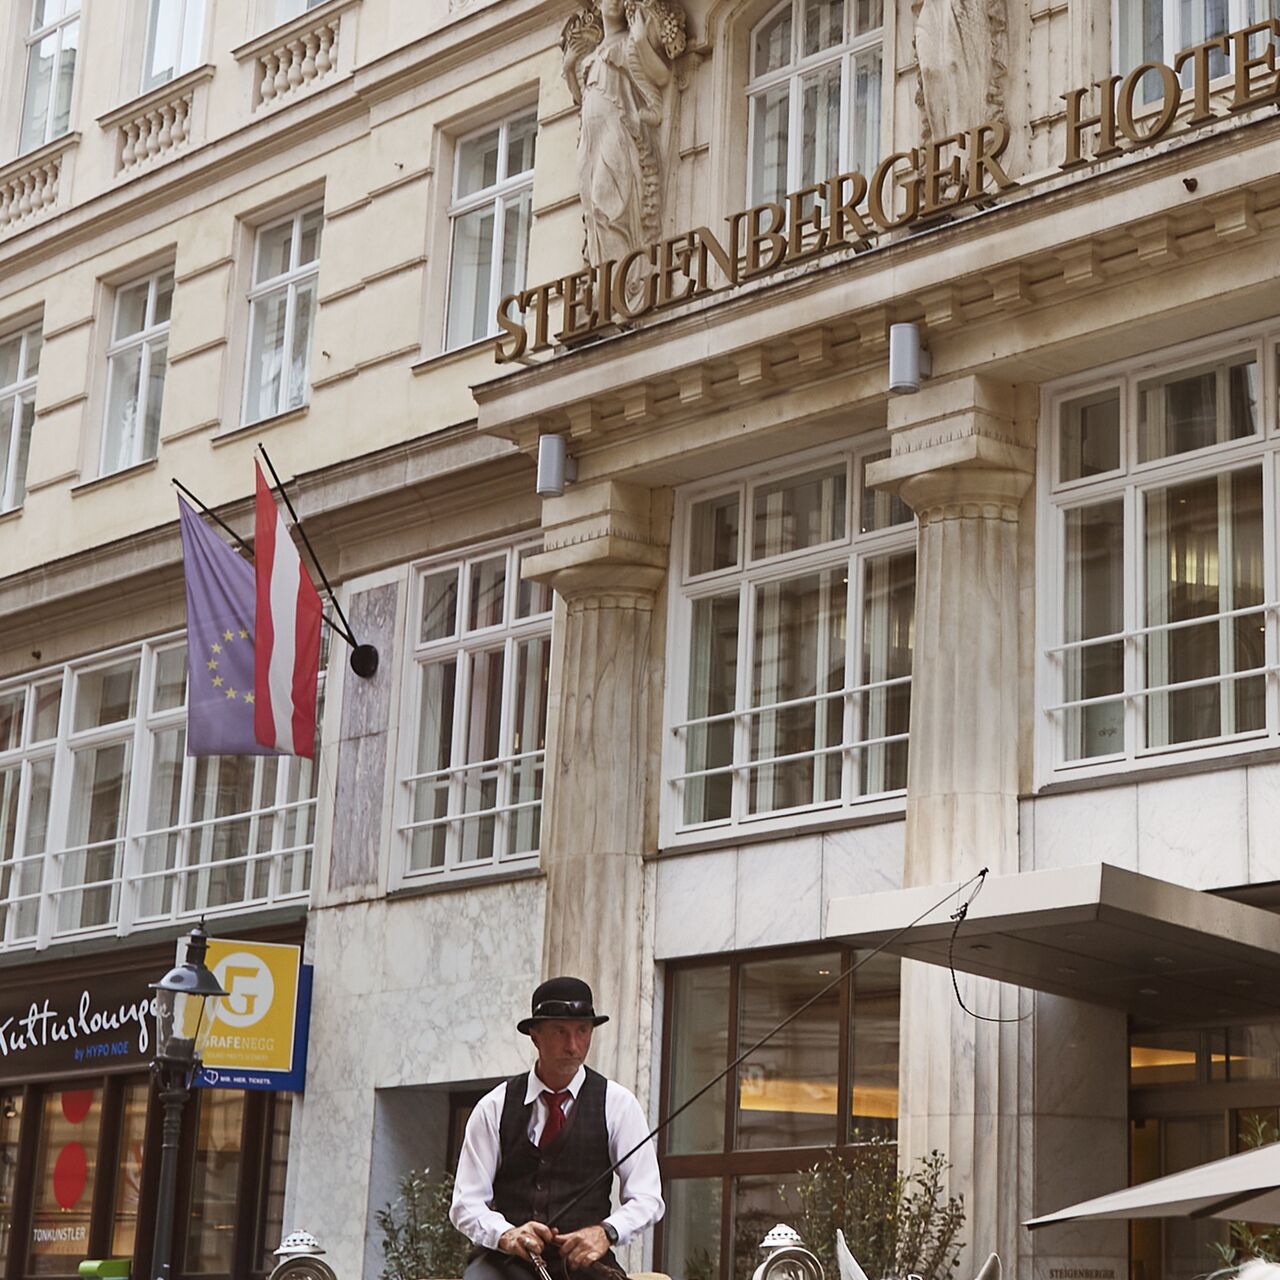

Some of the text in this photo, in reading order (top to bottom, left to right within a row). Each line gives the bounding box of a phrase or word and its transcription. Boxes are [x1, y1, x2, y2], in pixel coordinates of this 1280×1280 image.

[494, 120, 1021, 365] STEIGENBERGER
[85, 1044, 109, 1058] HYPO
[111, 1041, 129, 1055] NOE
